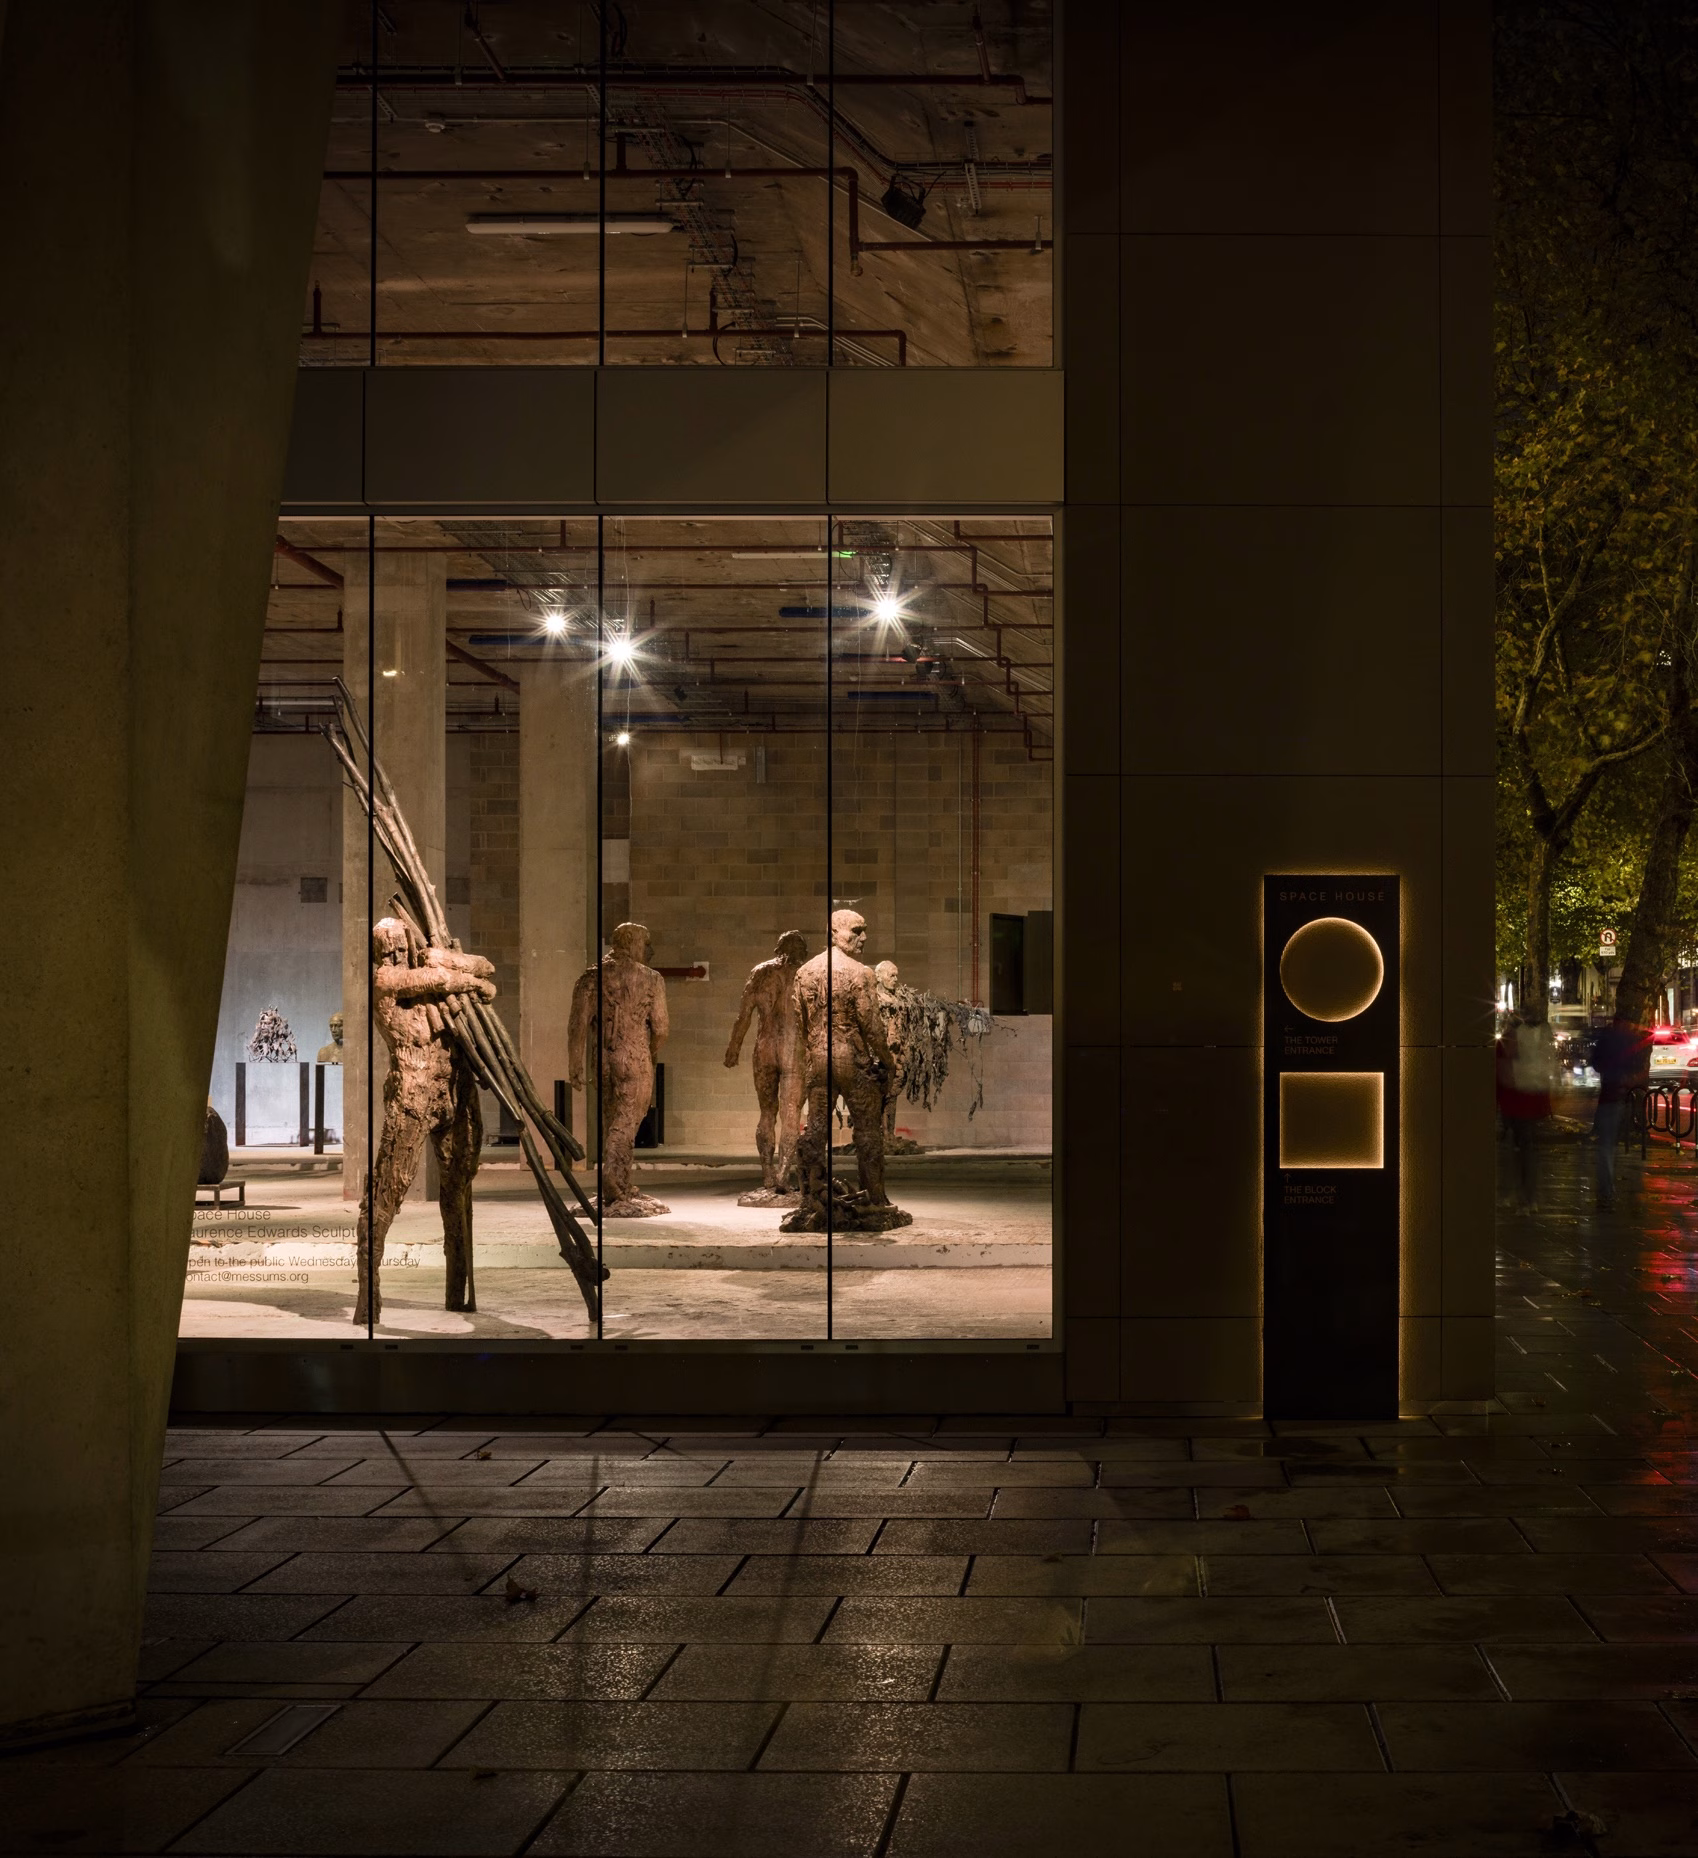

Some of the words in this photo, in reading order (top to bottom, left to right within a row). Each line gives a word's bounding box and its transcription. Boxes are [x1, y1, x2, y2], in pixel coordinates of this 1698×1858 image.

[1279, 891, 1327, 901] SPACE
[1335, 891, 1385, 901] HOUSE
[1284, 1036, 1303, 1044] THE
[1305, 1036, 1338, 1044] TOWER
[1284, 1046, 1335, 1055] ENTRANCE
[1284, 1185, 1302, 1194] THE
[1305, 1185, 1337, 1194] BLOCK
[1284, 1195, 1335, 1204] ENTRANCE
[227, 1208, 271, 1220] House
[247, 1226, 308, 1238] Edwards
[188, 1257, 210, 1268] pen
[214, 1257, 225, 1267] to
[229, 1256, 246, 1267] the
[249, 1256, 285, 1268] public
[288, 1256, 357, 1268] Wednesday
[371, 1256, 420, 1268] ursday
[186, 1271, 309, 1283] ontact@messums.org
